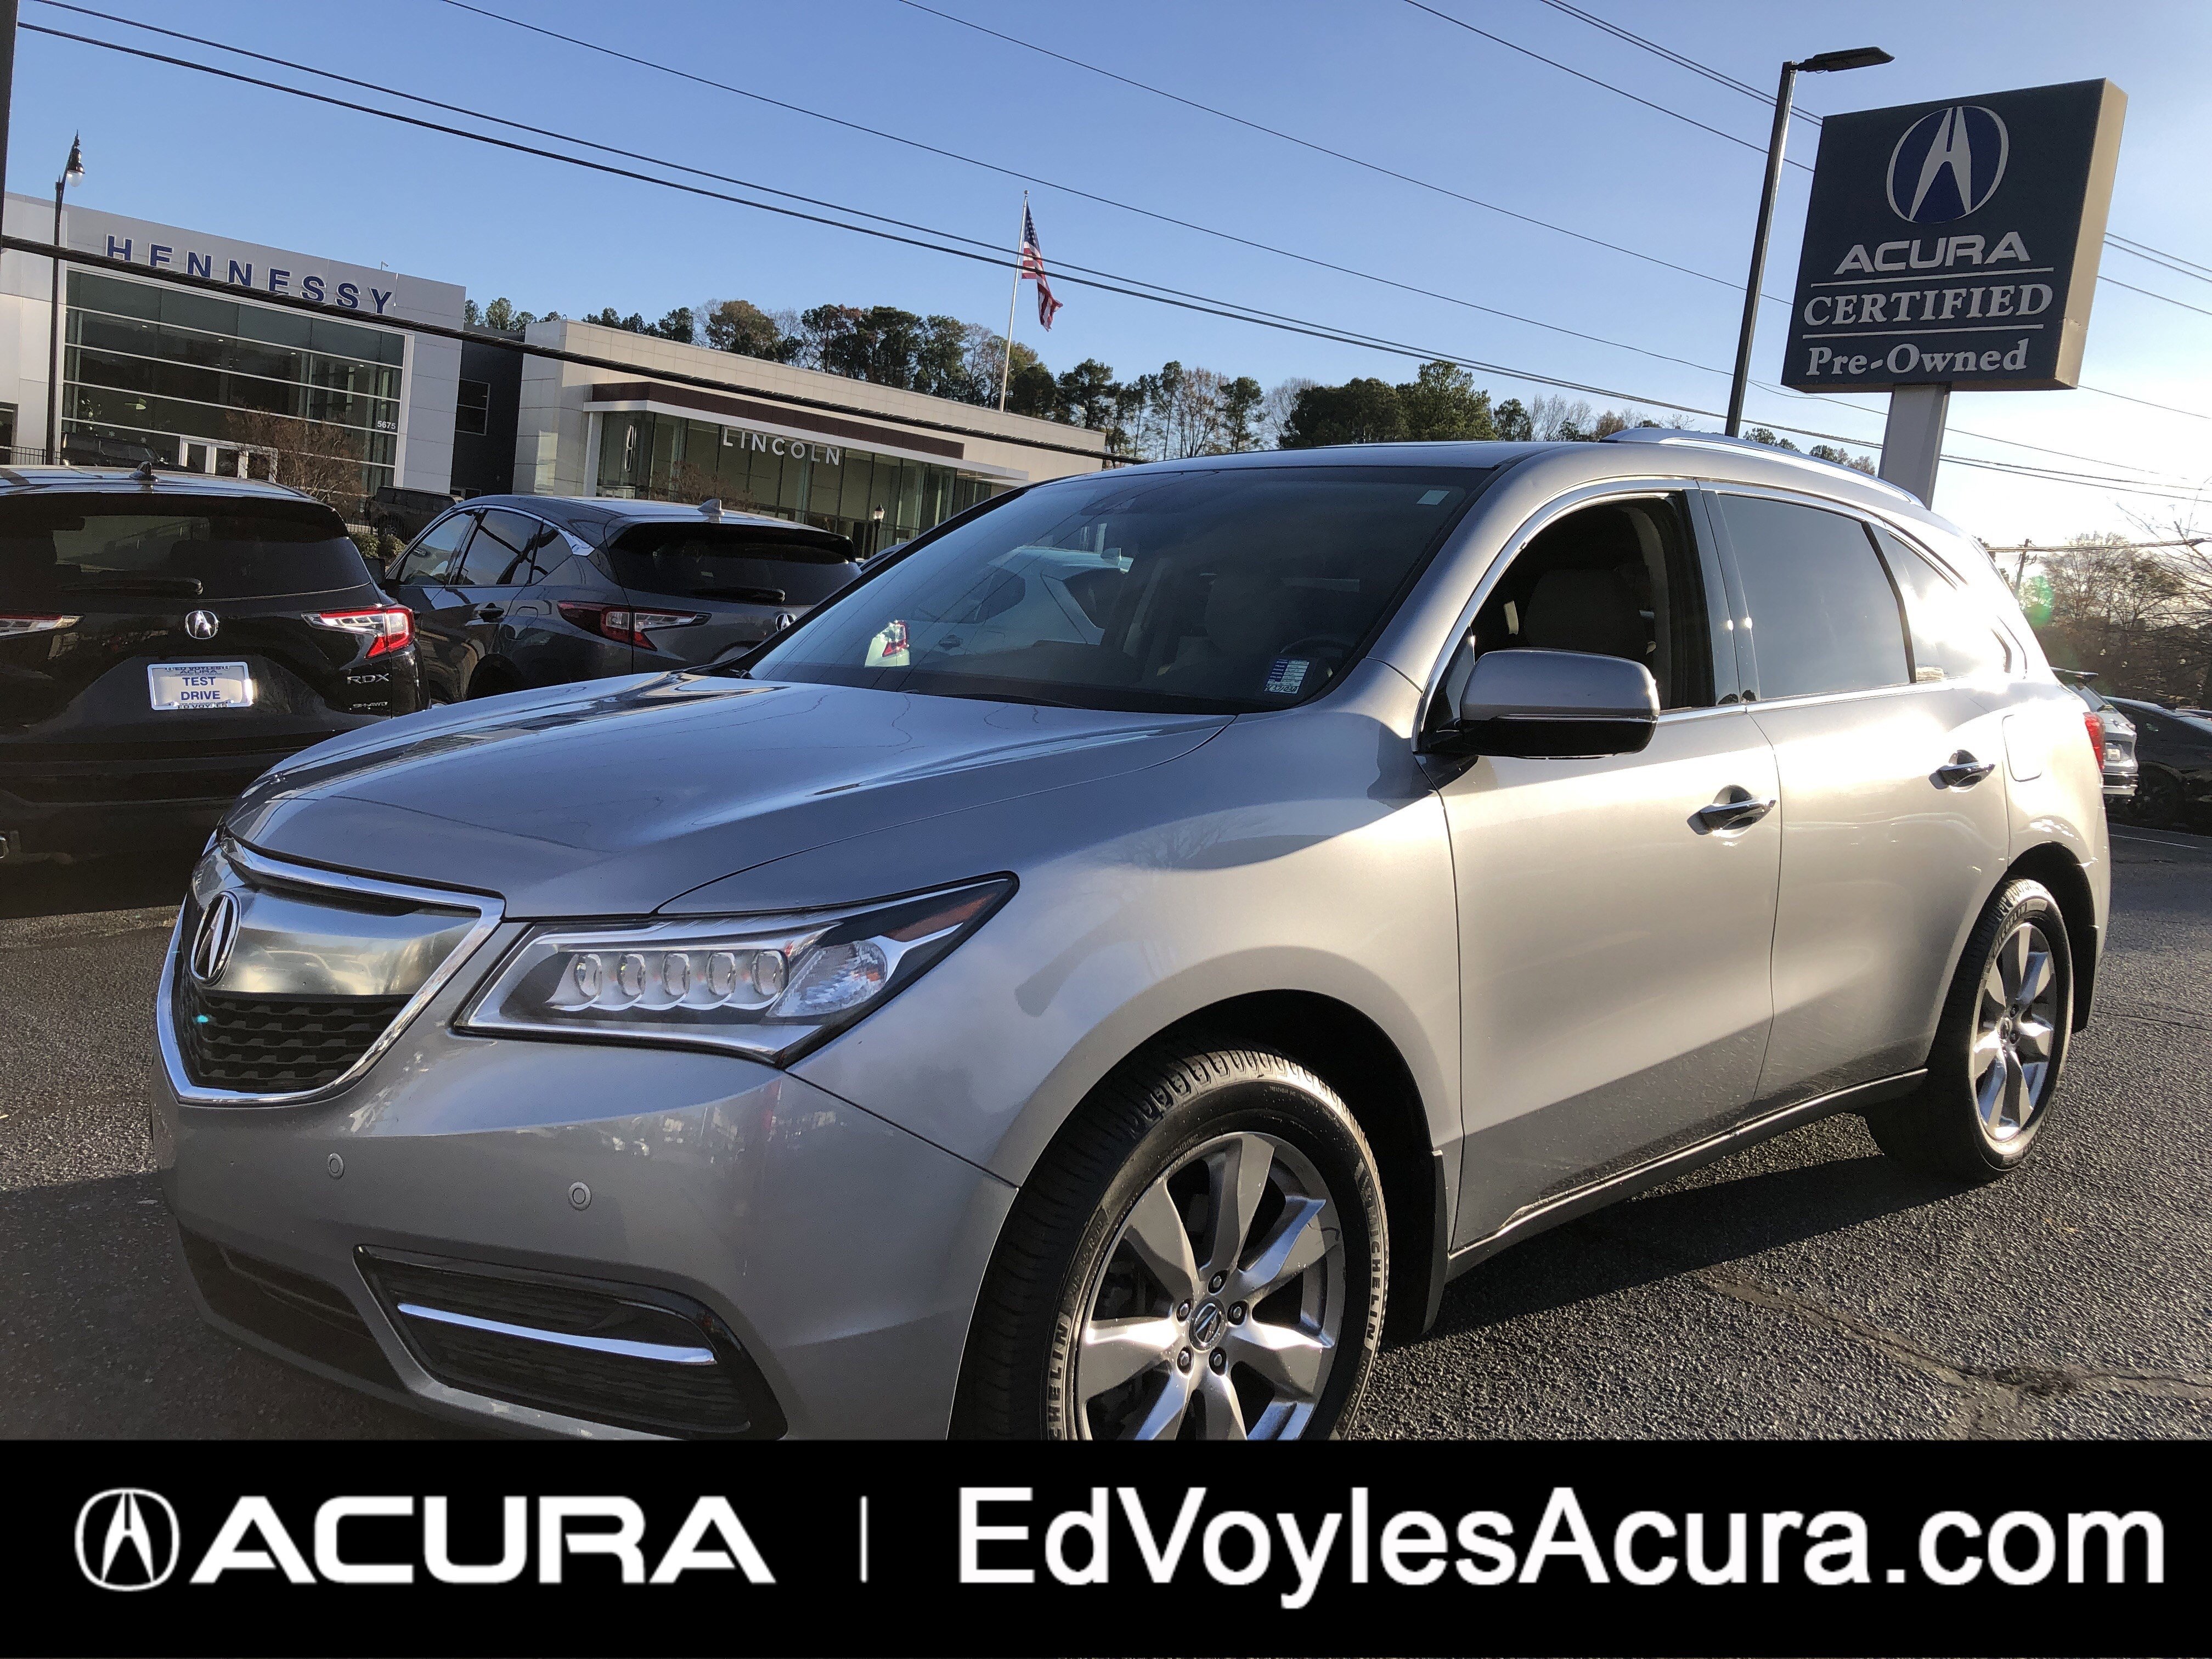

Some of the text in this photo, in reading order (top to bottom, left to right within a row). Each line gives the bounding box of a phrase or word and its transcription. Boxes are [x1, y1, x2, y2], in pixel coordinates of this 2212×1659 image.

[1834, 231, 2031, 274] ACURA
[105, 234, 393, 314] HENNESSY
[1803, 283, 2053, 326] CERTIFIED
[1805, 338, 2028, 376] Pre-Owned
[377, 420, 396, 430] 5675
[723, 427, 840, 466] LINCOLN
[180, 690, 221, 701] DRIVE
[182, 676, 216, 686] TEST
[347, 673, 390, 684] RDX
[1366, 1205, 1381, 1341] MICHELIN
